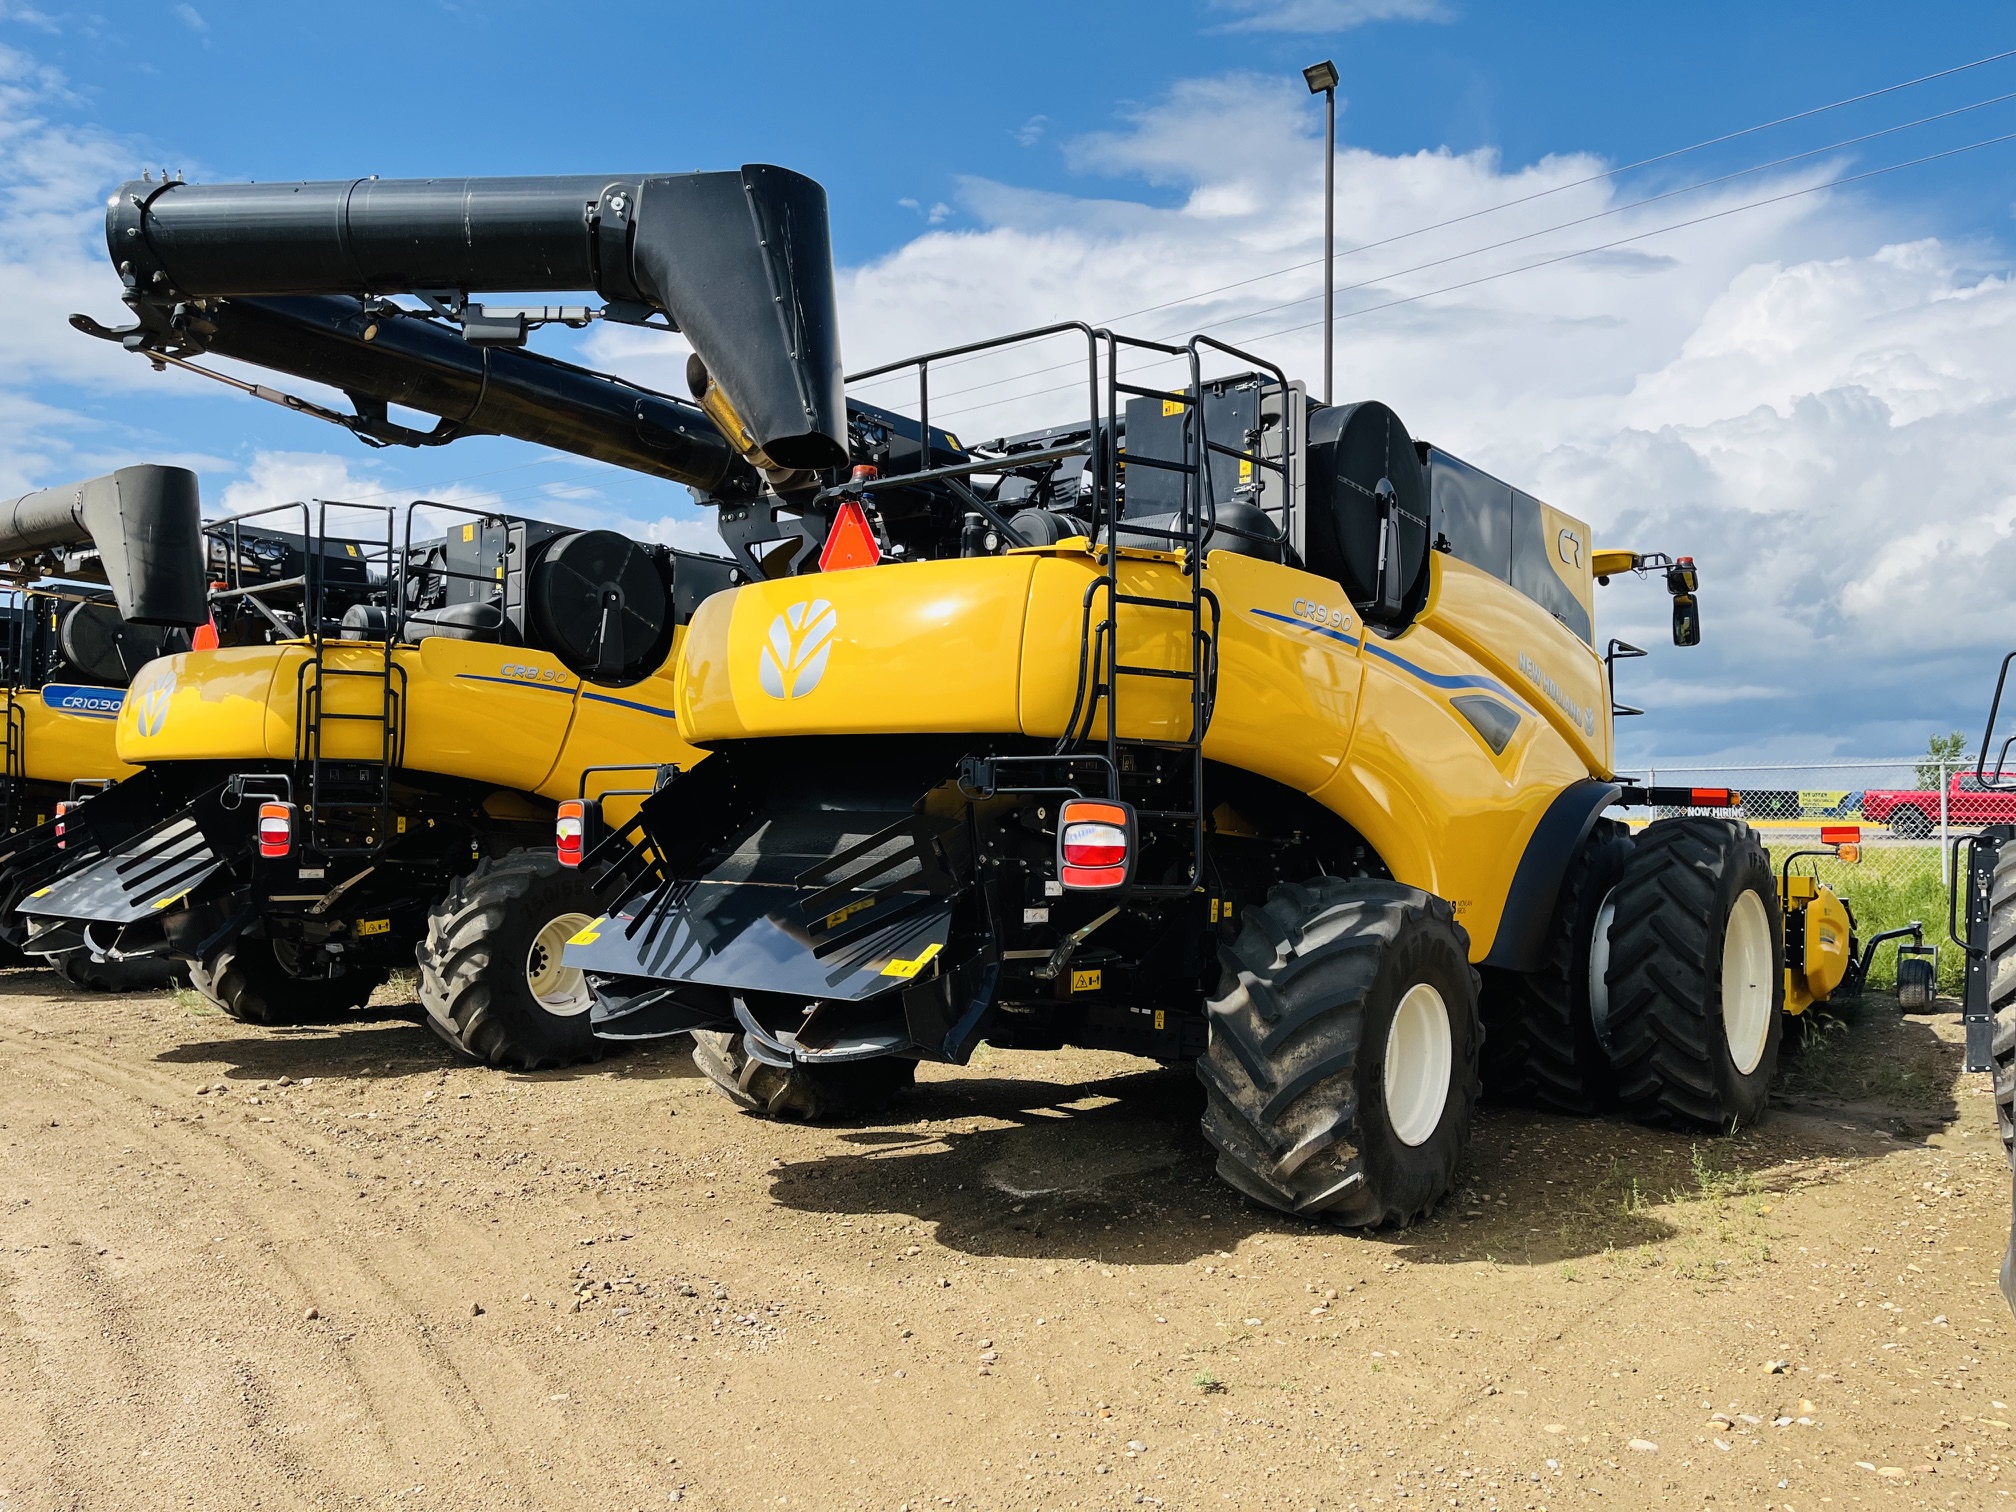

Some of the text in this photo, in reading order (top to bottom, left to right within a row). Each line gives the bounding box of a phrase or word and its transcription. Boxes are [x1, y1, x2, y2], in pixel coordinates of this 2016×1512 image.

[1558, 528, 1582, 570] CR
[1293, 597, 1352, 631] CR9.90
[501, 663, 568, 683] CR8.90
[1518, 650, 1582, 728] NEW HOLLAND
[62, 696, 122, 711] CR10.90
[1687, 806, 1745, 818] NOW HIRING
